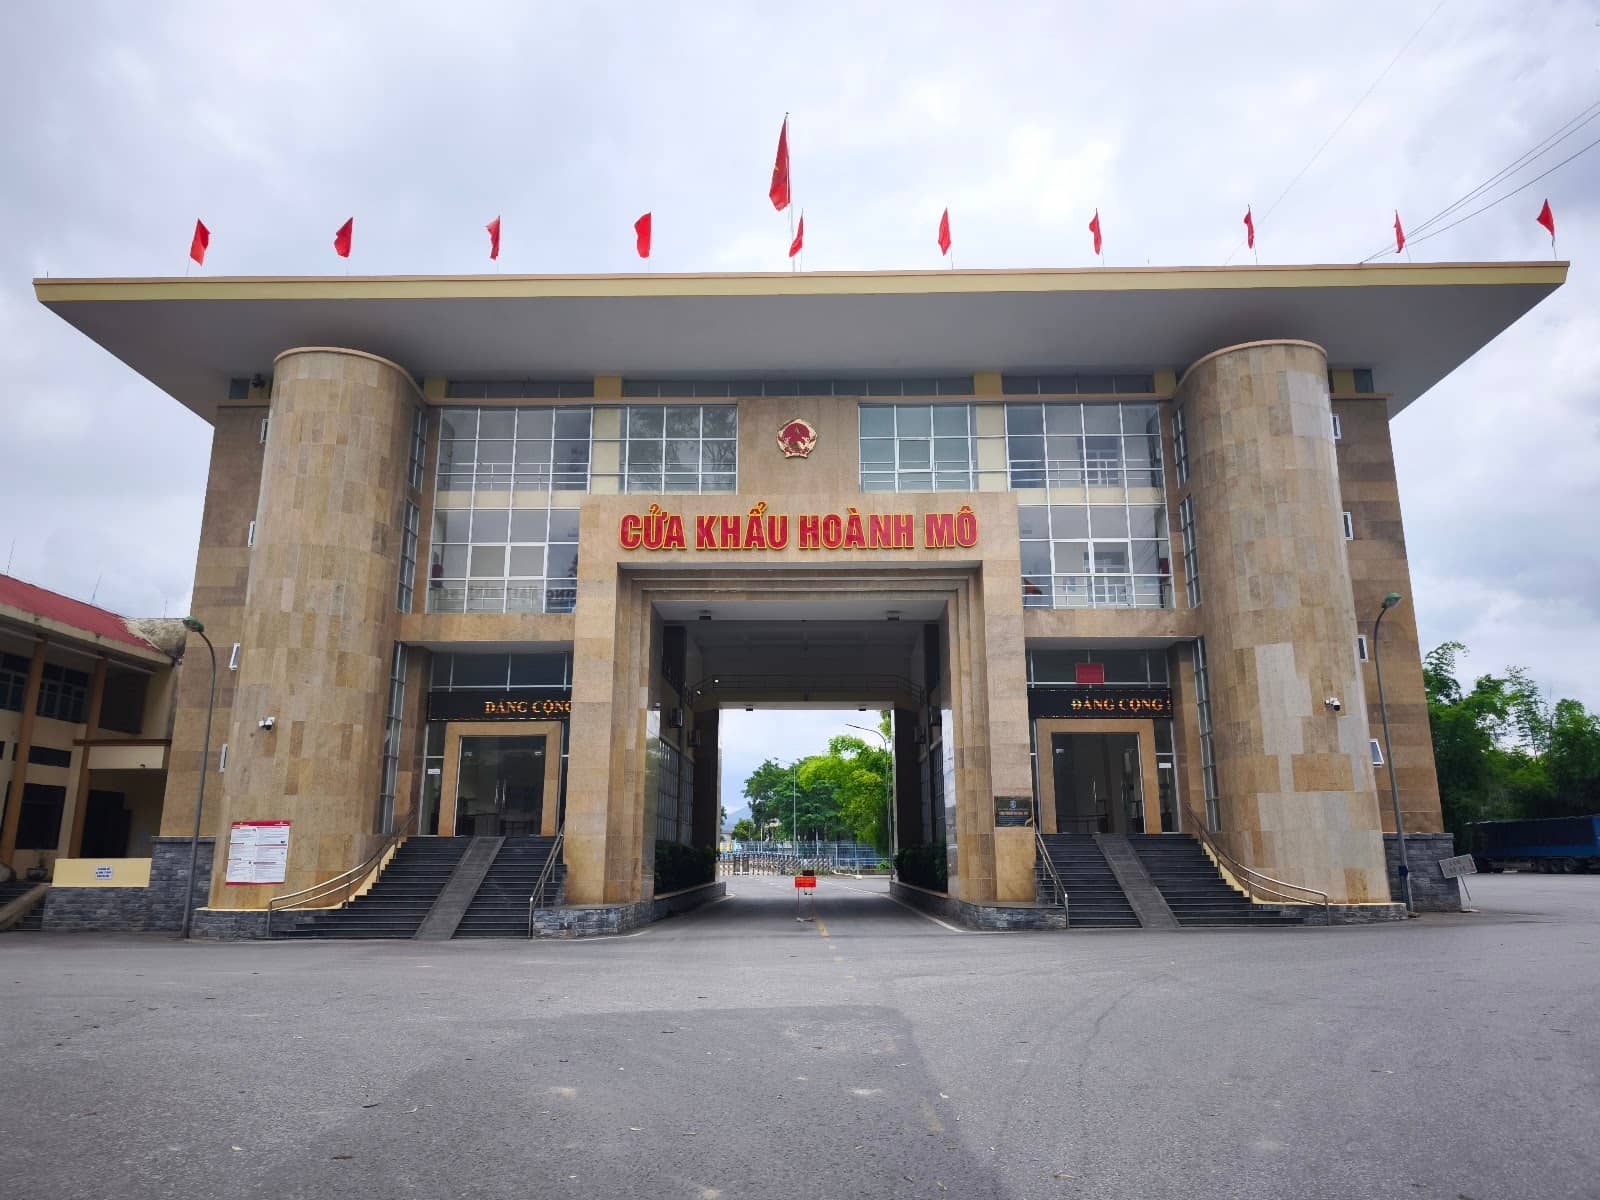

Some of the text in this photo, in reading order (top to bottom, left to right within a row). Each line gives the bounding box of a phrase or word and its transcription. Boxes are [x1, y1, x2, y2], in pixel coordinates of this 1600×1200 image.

[619, 501, 979, 550] CỬA KHẨU HOÀNH MÔ
